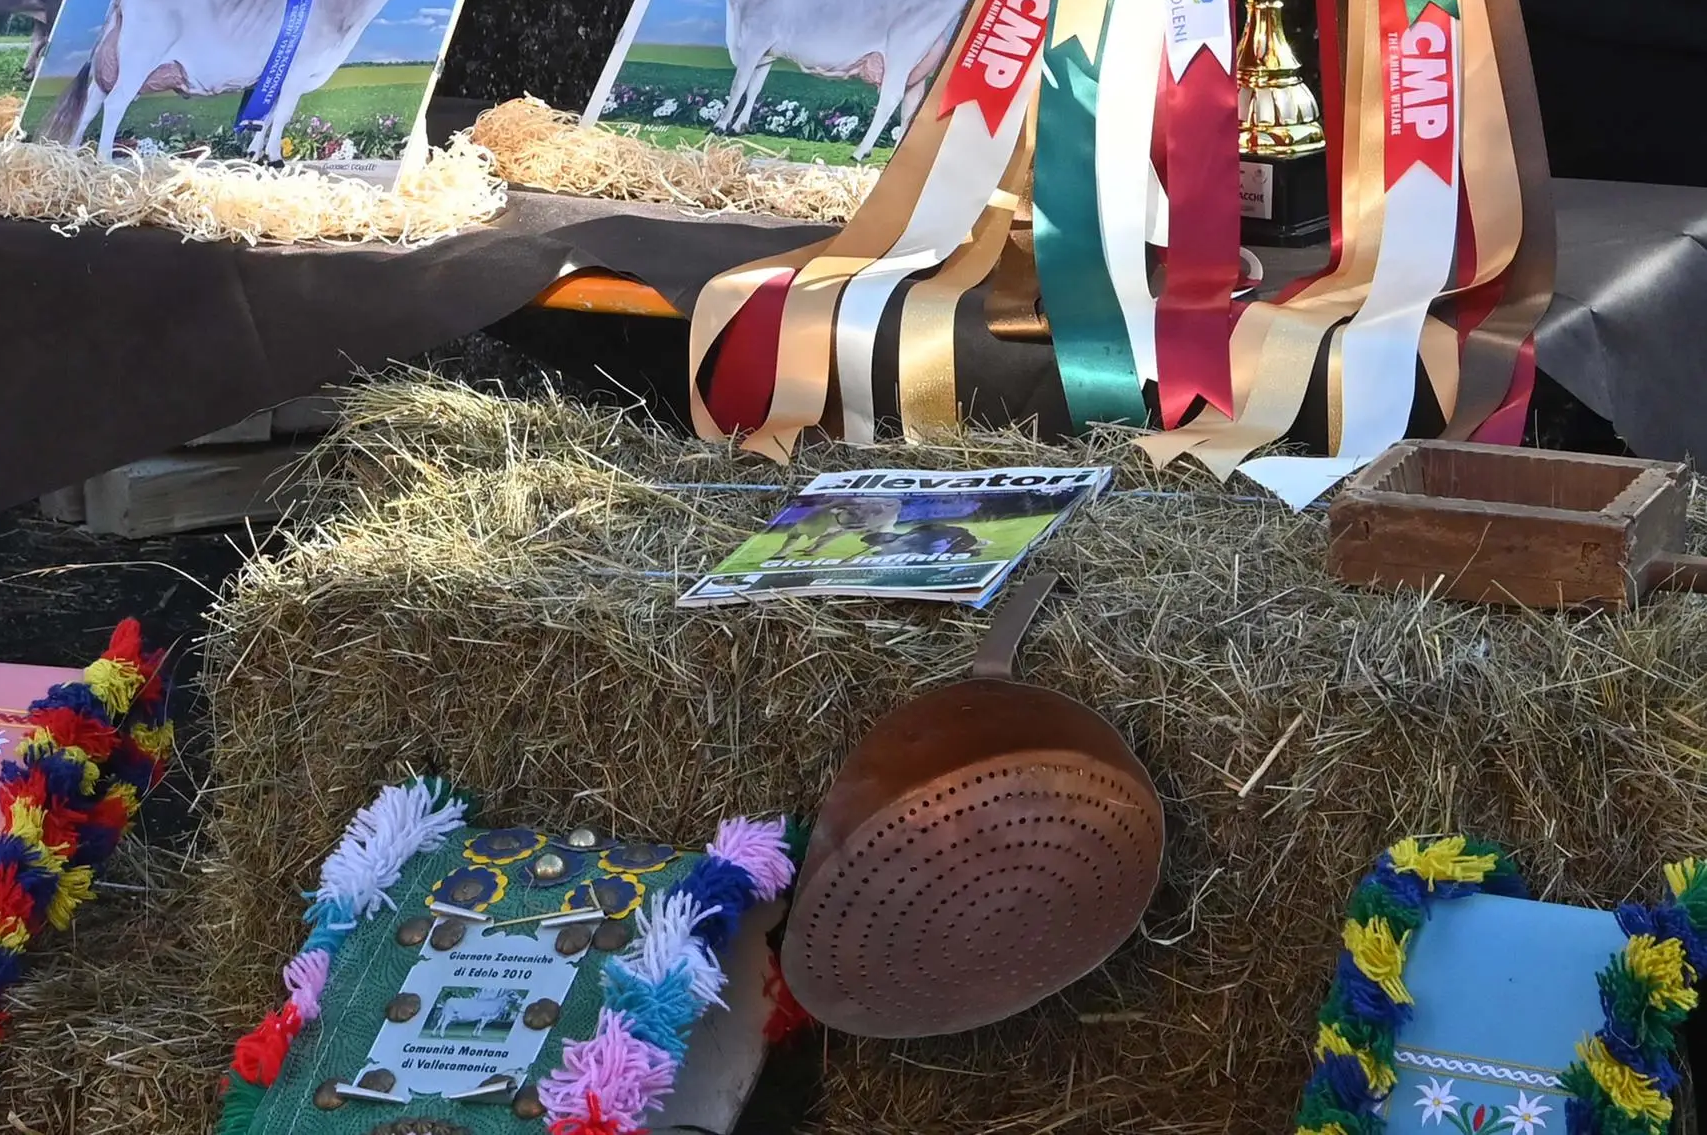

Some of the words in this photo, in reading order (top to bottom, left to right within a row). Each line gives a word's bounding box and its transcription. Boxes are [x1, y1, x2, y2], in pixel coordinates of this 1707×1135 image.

[980, 1, 1002, 32] ANIMAL
[961, 31, 987, 69] WELFARE
[1388, 32, 1398, 50] THE
[1389, 53, 1401, 91] ANIMAL
[1401, 21, 1448, 140] CMP
[1390, 93, 1402, 136] WELFARE
[449, 951, 493, 963] Giornate
[495, 952, 554, 965] Zootecniche
[454, 966, 465, 978] di
[468, 967, 499, 979] Edolo
[501, 968, 533, 980] 2010
[403, 1042, 455, 1056] Comunità
[457, 1045, 509, 1059] Montana
[401, 1059, 414, 1070] di
[417, 1059, 498, 1074] Vallecamonica
